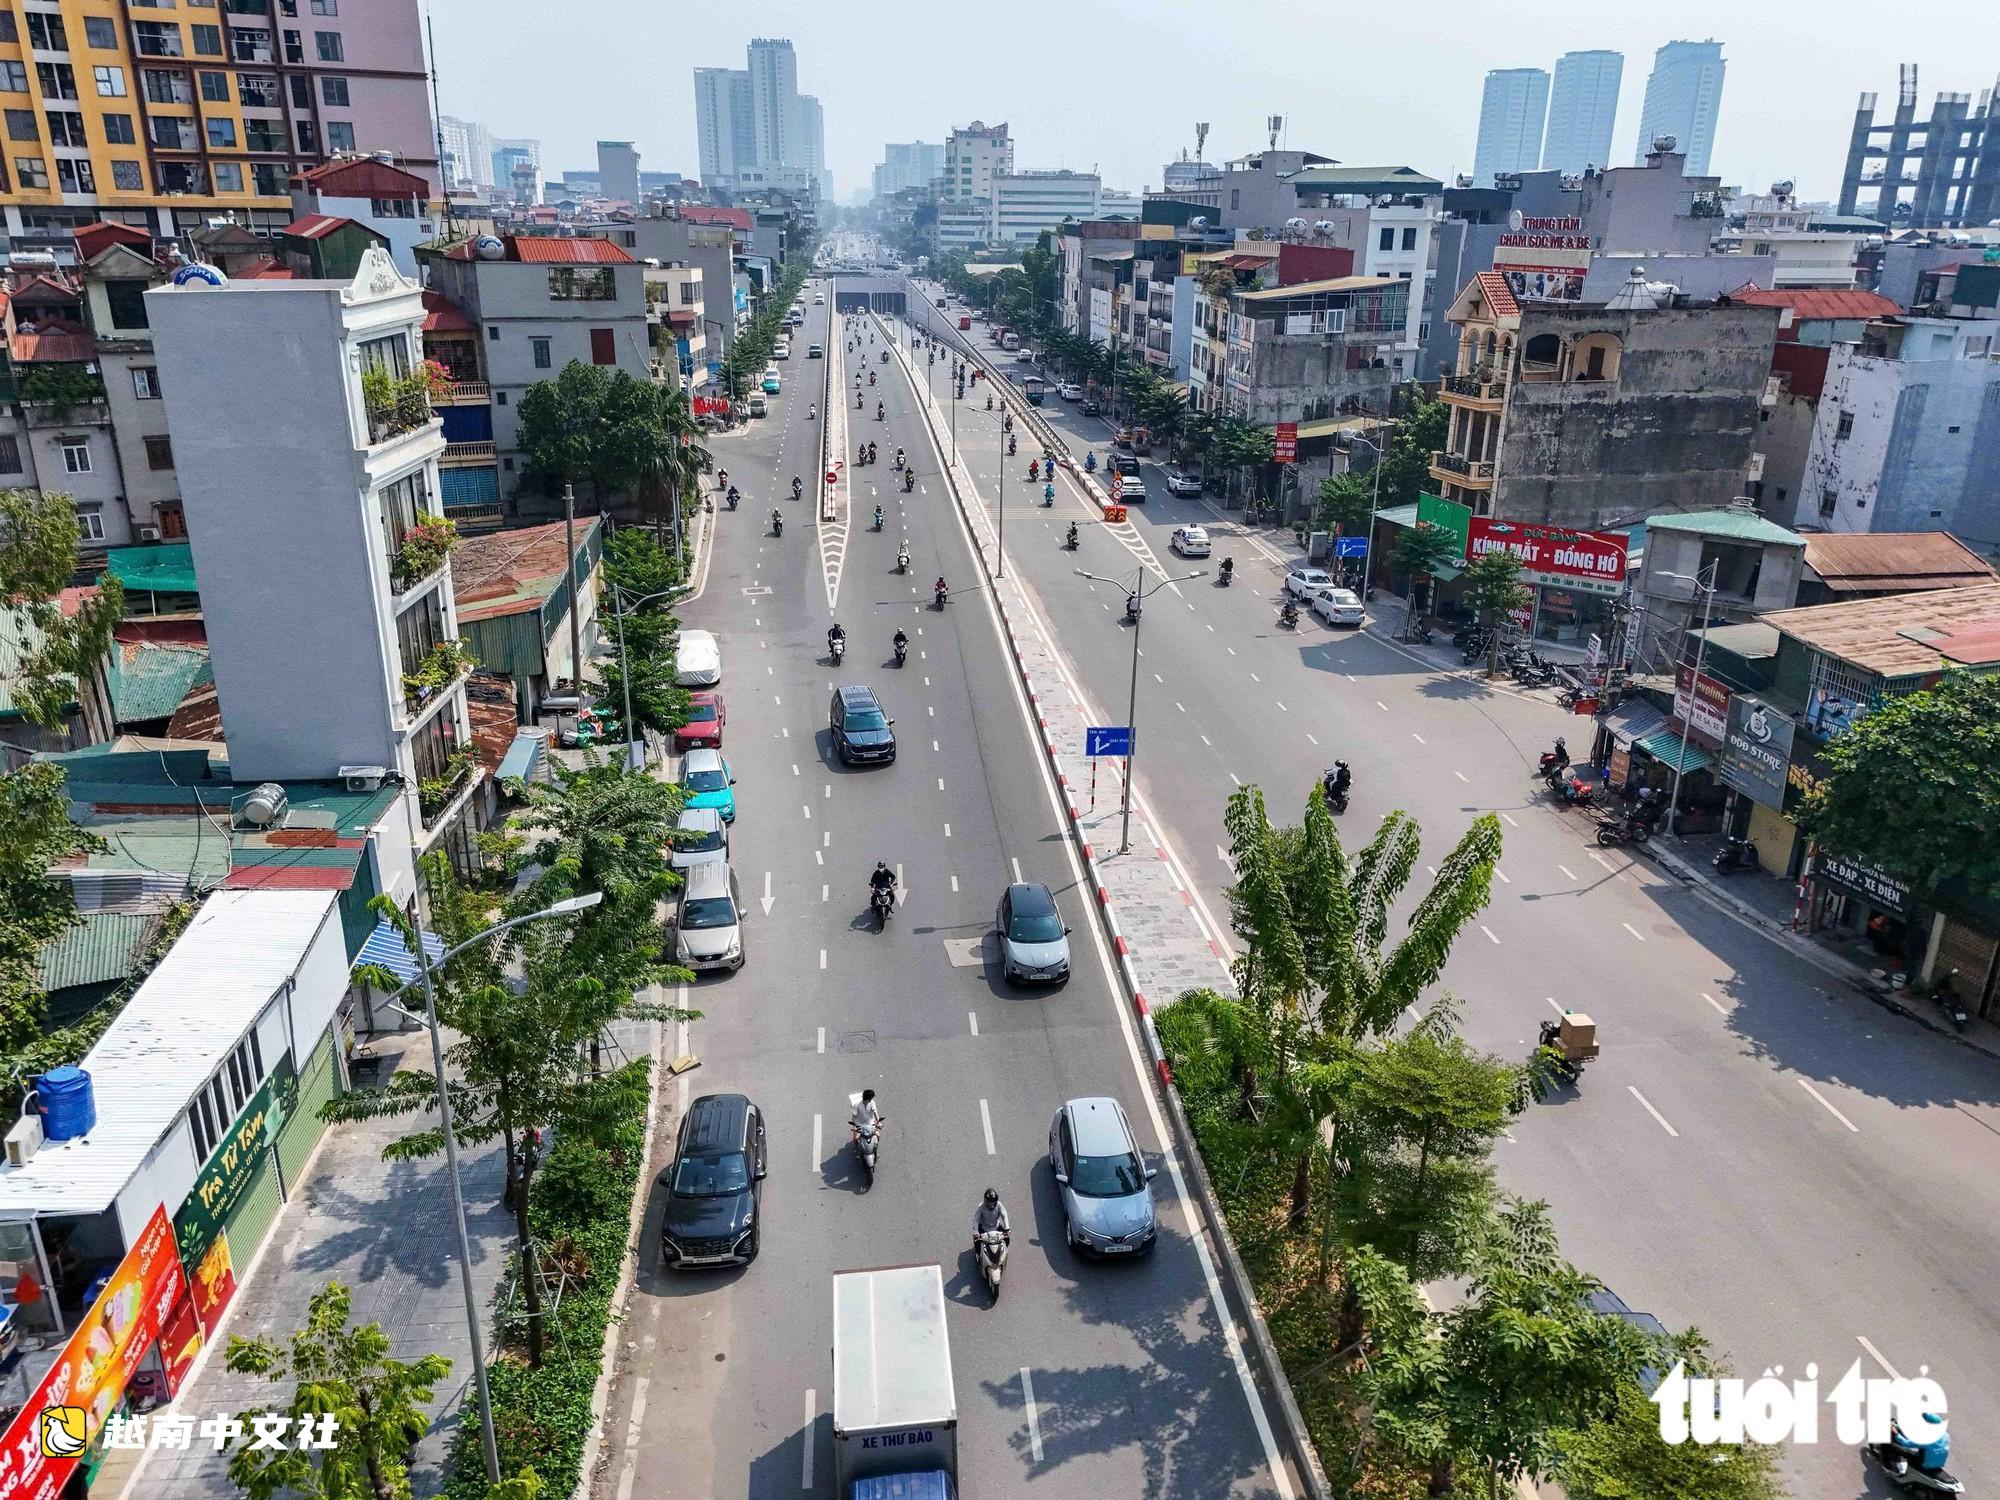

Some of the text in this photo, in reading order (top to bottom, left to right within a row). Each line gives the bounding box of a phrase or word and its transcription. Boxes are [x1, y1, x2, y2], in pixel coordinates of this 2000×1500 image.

[1524, 217, 1557, 230] TRUNG
[1566, 235, 1577, 250] &
[1472, 535, 1507, 555] KÍNH
[1509, 539, 1541, 562] MẮT
[1553, 544, 1595, 570] ĐỒNG
[1597, 550, 1619, 573] HỒ
[1696, 681, 1726, 703] avoline
[1750, 745, 1782, 771] STORE
[1826, 858, 1838, 874] XE
[1839, 864, 1858, 882] ĐẠP
[1864, 876, 1876, 892] XE
[1877, 883, 1900, 904] ĐIỆN
[1879, 874, 1895, 887] MUA
[862, 1429, 933, 1449] XE THƯ BÁO
